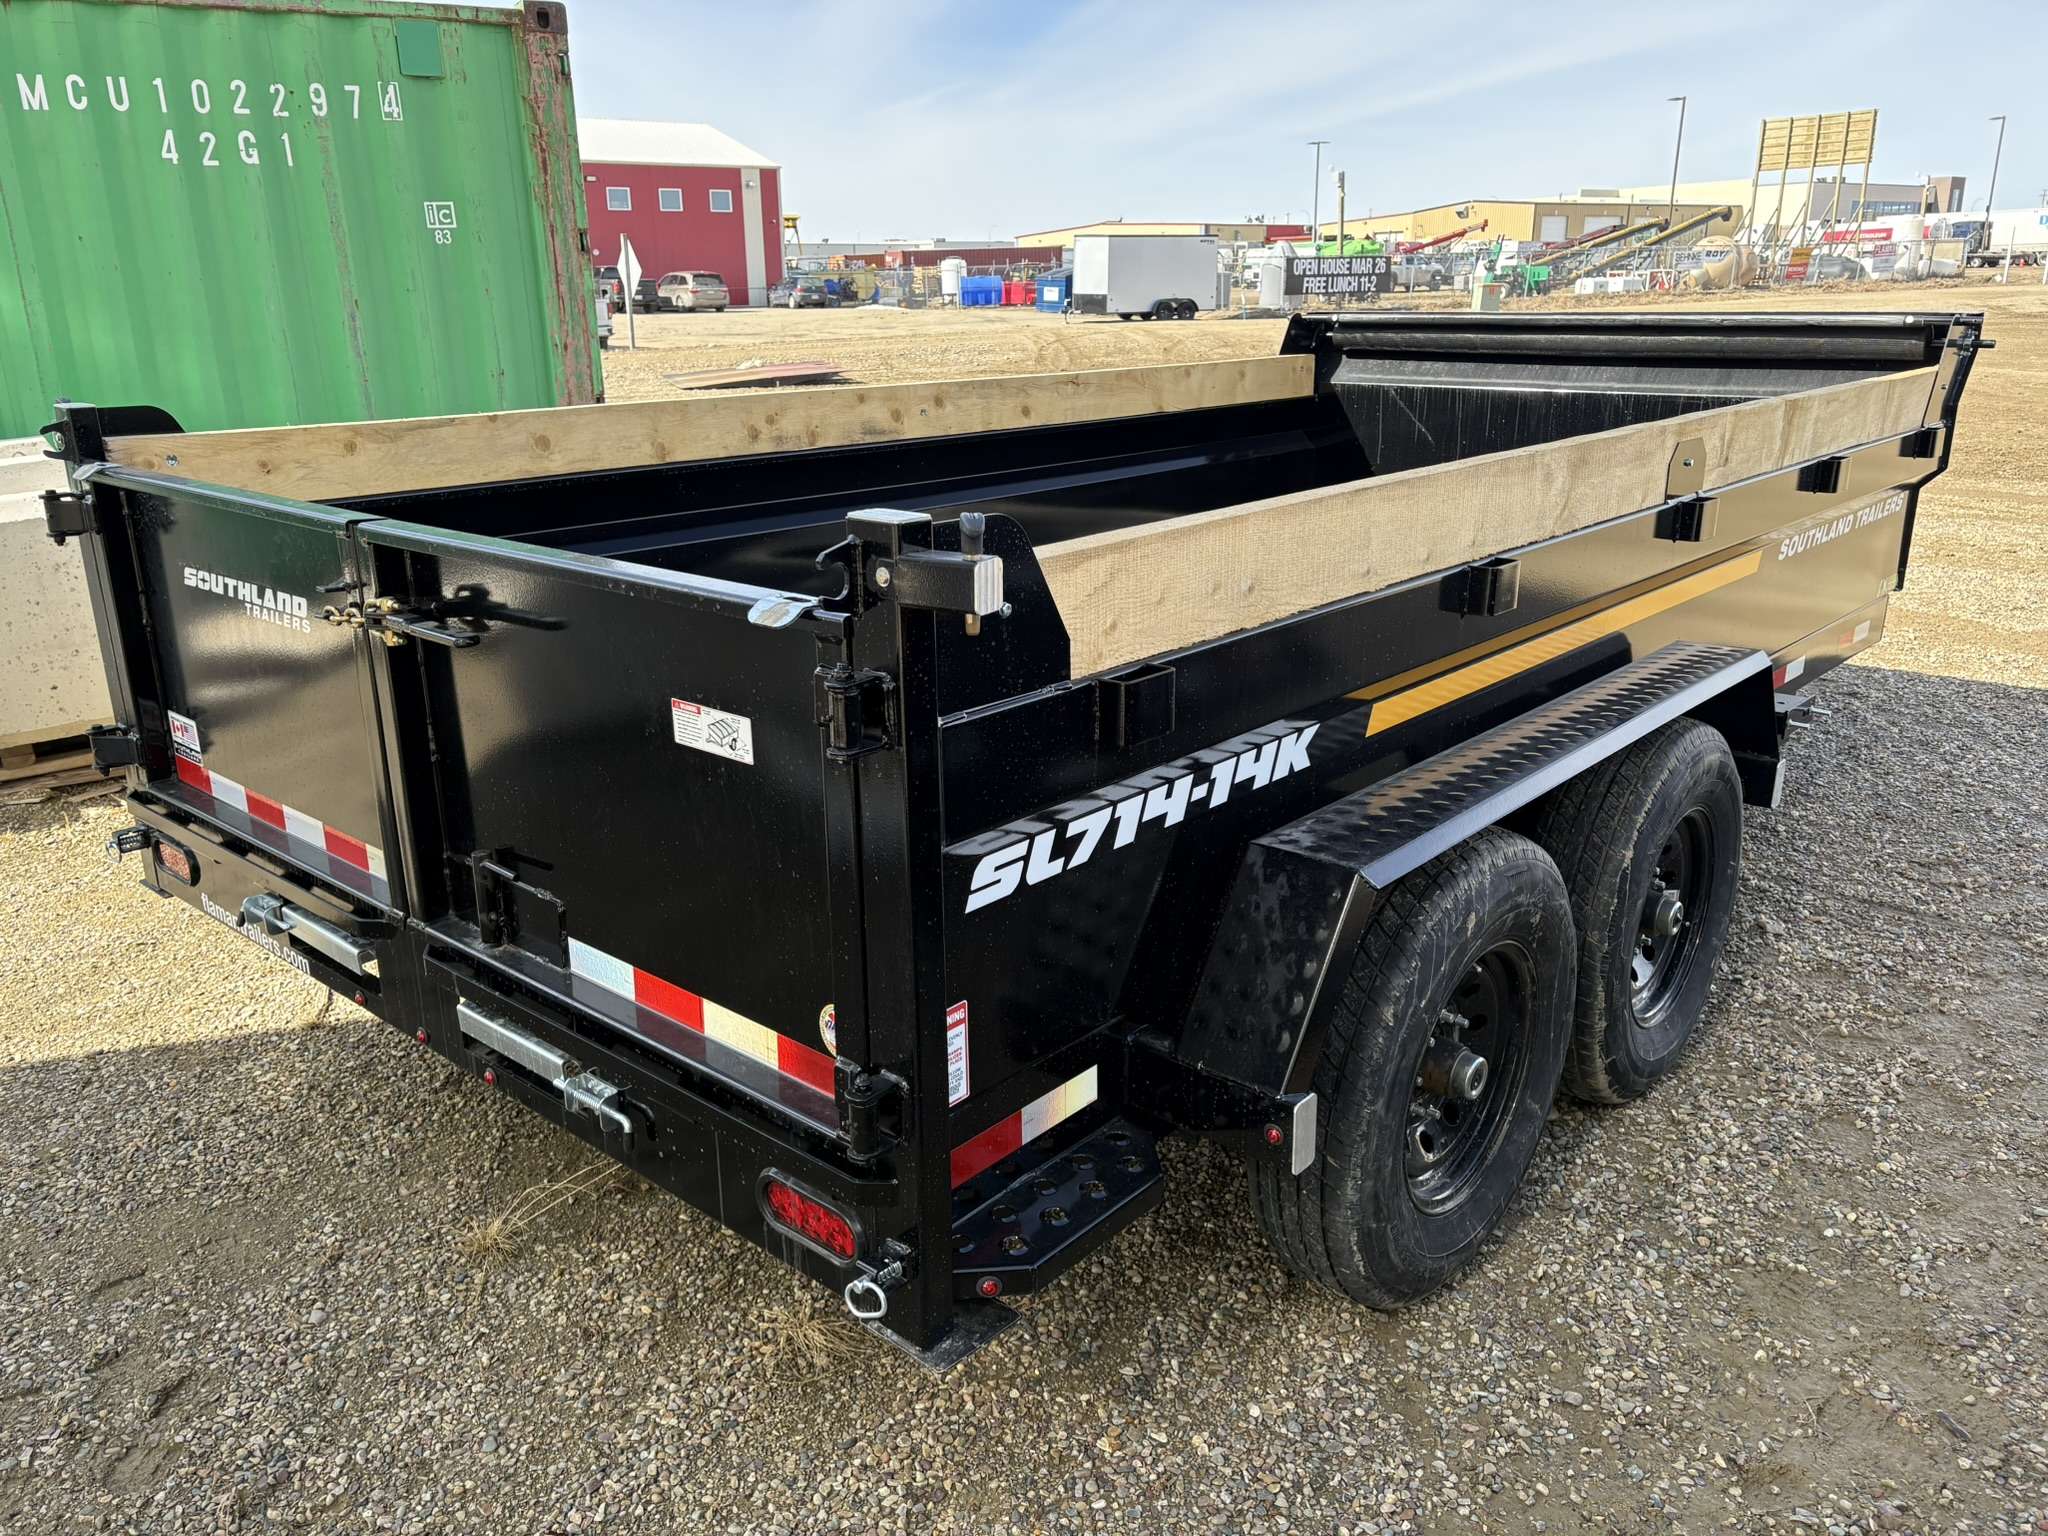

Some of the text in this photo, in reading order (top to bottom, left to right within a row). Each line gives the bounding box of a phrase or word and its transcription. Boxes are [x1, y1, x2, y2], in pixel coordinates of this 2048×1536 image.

[162, 129, 293, 167] 42G1
[434, 230, 452, 244] 83
[1293, 258, 1386, 275] OPEN HOUSE MAR 26
[1303, 275, 1377, 293] FREE LUNCH 11-2
[1778, 494, 1904, 560] SOUTHLAND TRAILERS
[184, 566, 308, 619] SOUTHLAND
[244, 602, 311, 634] TRAILERS
[965, 723, 1320, 914] SL714-14K
[947, 1008, 965, 1025] NING
